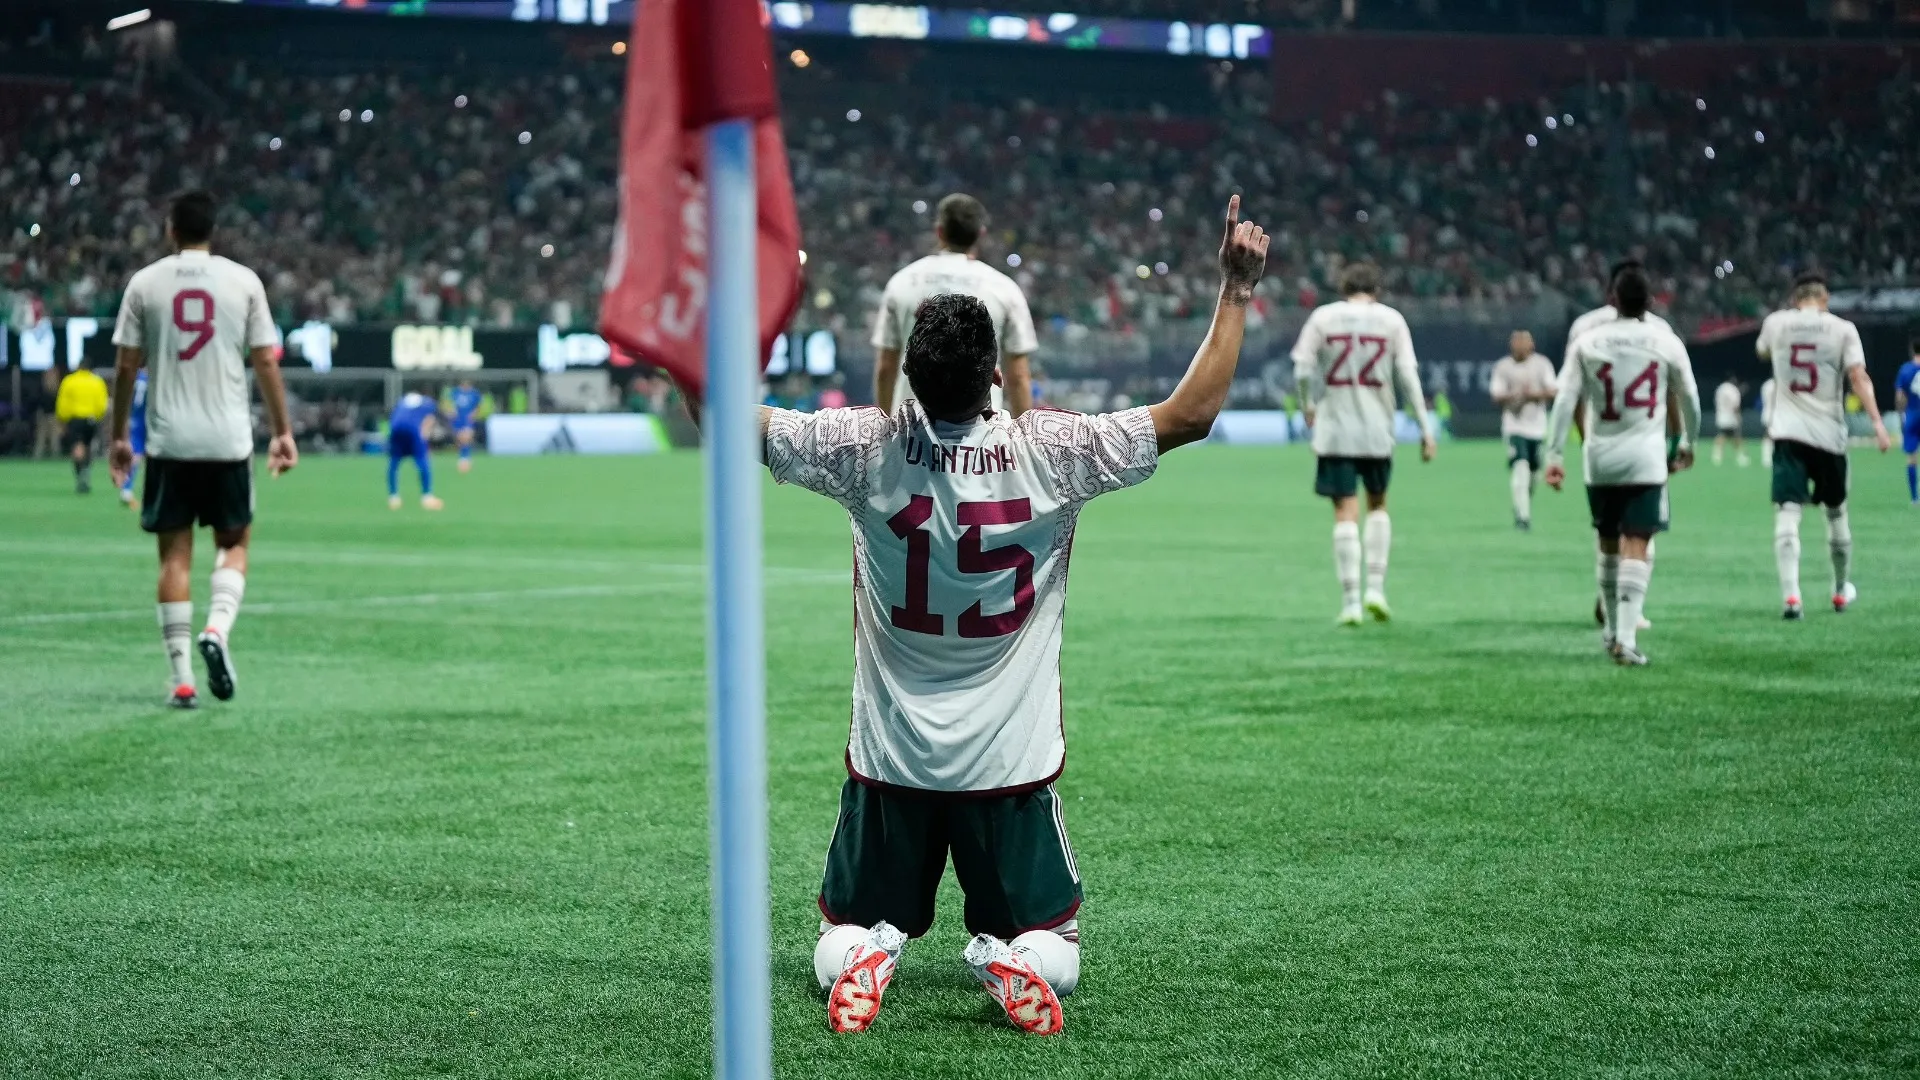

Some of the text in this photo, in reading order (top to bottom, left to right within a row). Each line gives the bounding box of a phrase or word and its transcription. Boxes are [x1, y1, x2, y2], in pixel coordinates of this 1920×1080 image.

[172, 288, 215, 361] 9
[391, 325, 483, 370] GOAL
[1325, 334, 1387, 387] 22
[1790, 343, 1818, 393] 5
[1596, 360, 1659, 421] 14
[886, 493, 1036, 639] 15
